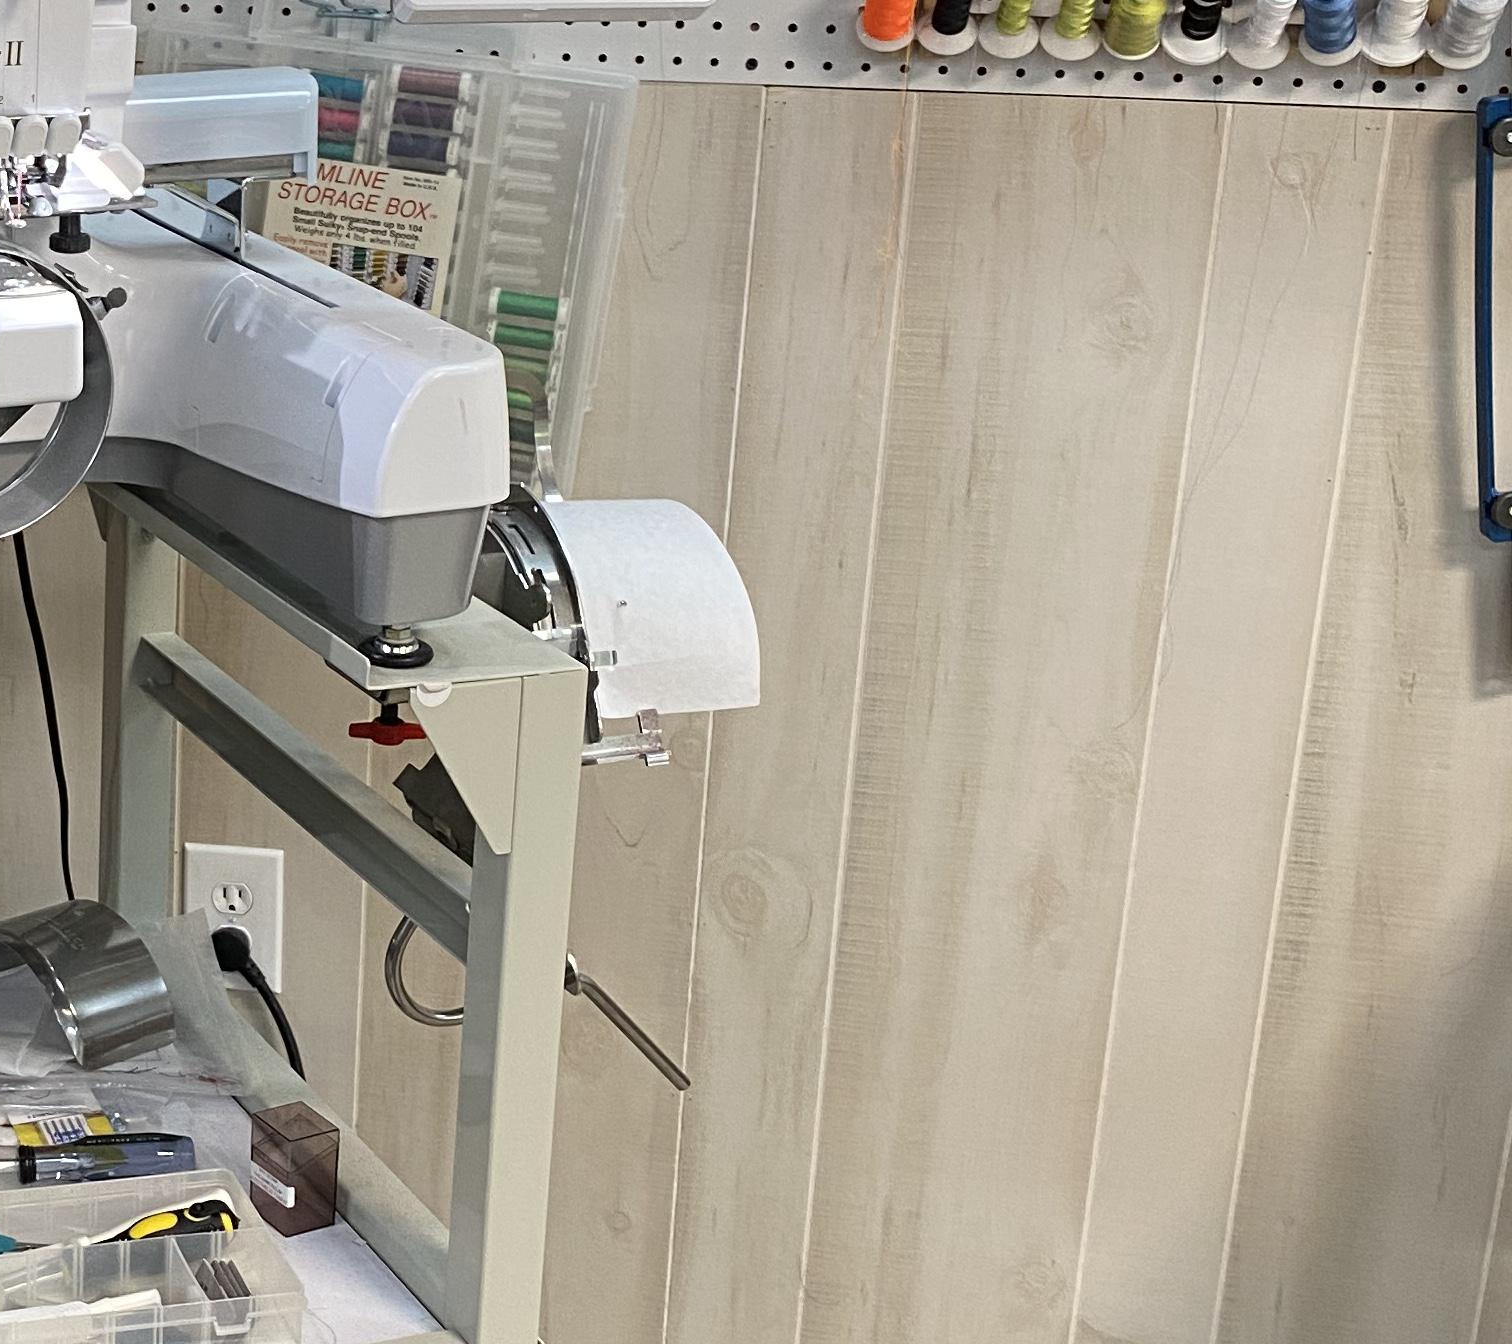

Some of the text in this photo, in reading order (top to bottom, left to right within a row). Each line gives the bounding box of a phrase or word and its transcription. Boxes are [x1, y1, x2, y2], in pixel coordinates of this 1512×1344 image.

[4, 40, 25, 67] II
[278, 181, 381, 213] STORAGE
[397, 222, 405, 230] to
